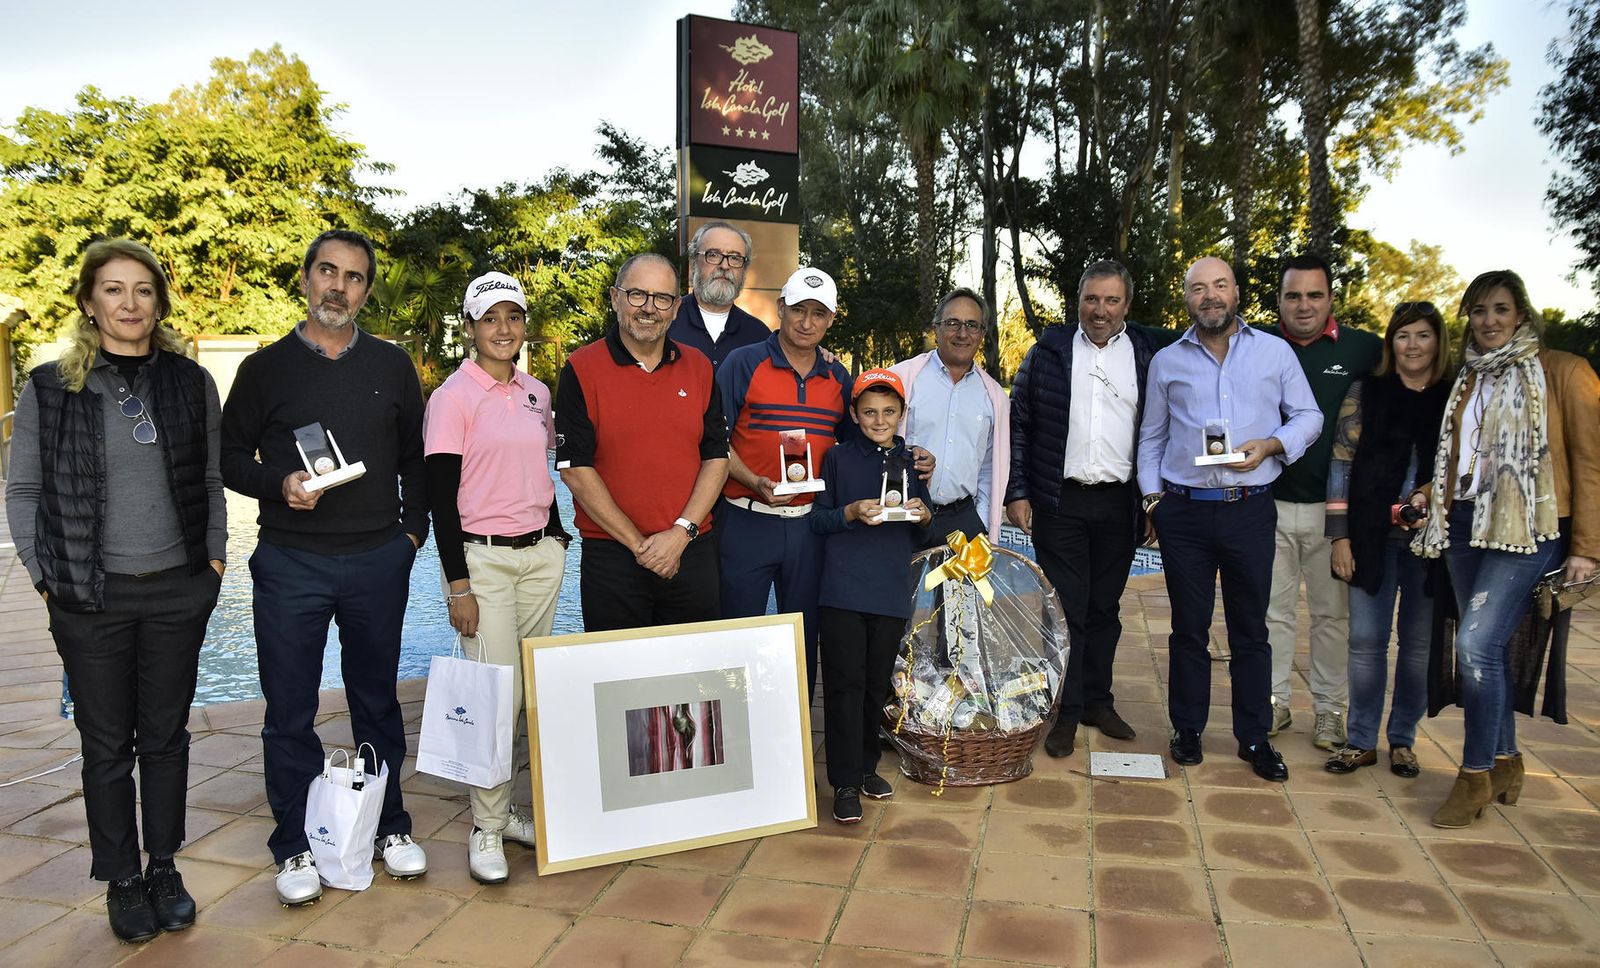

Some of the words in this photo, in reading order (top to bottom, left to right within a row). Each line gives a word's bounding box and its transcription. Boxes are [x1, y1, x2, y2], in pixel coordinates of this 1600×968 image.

[728, 68, 764, 94] Hotel
[700, 86, 721, 109] Isla
[722, 94, 761, 116] Canela
[762, 95, 789, 126] Golf
[702, 181, 721, 203] Isla
[722, 187, 761, 208] Canela
[762, 187, 789, 216] Golf
[473, 280, 518, 298] Titleist
